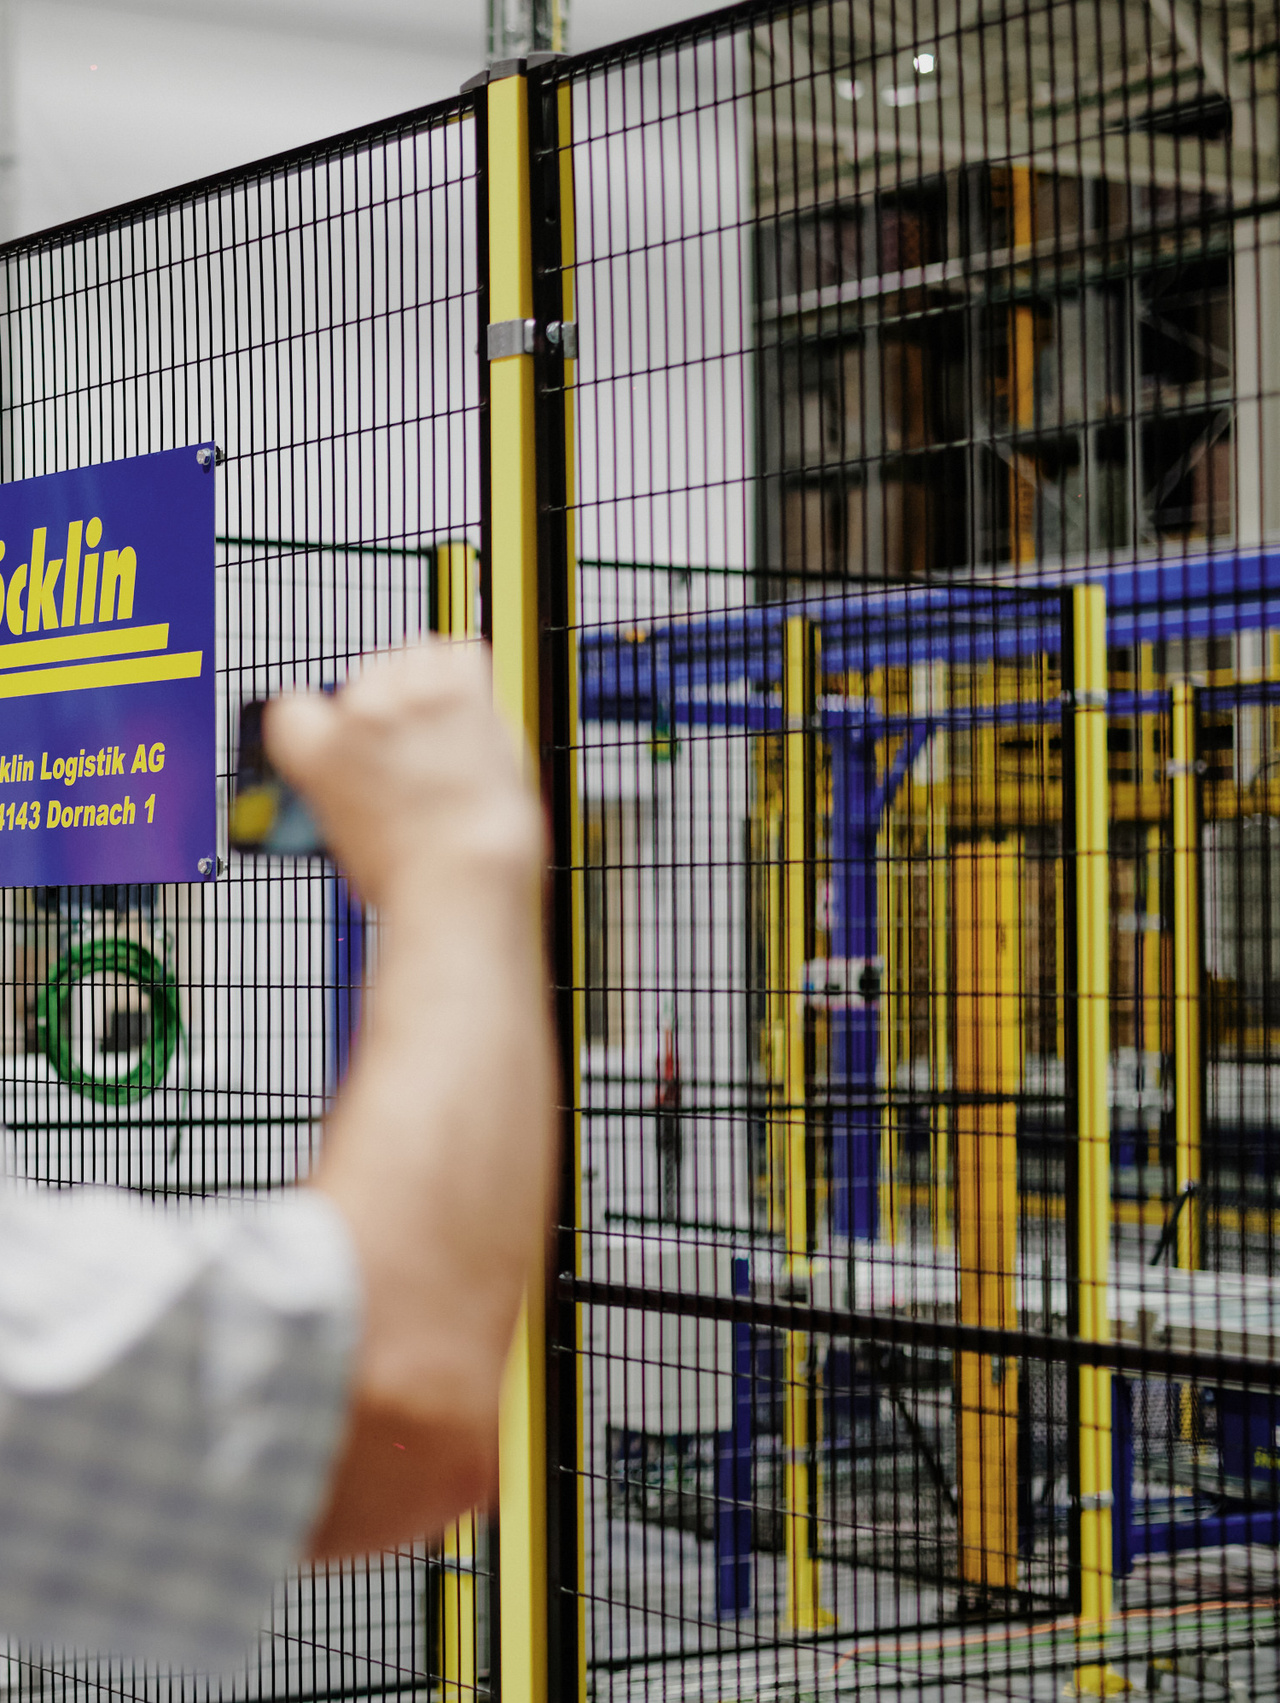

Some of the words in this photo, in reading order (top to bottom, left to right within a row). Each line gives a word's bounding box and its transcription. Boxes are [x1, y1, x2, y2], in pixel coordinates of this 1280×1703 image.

[40, 747, 126, 787] Logistik
[131, 742, 166, 774] AG
[46, 796, 136, 829] Dornach
[144, 794, 156, 824] 1
